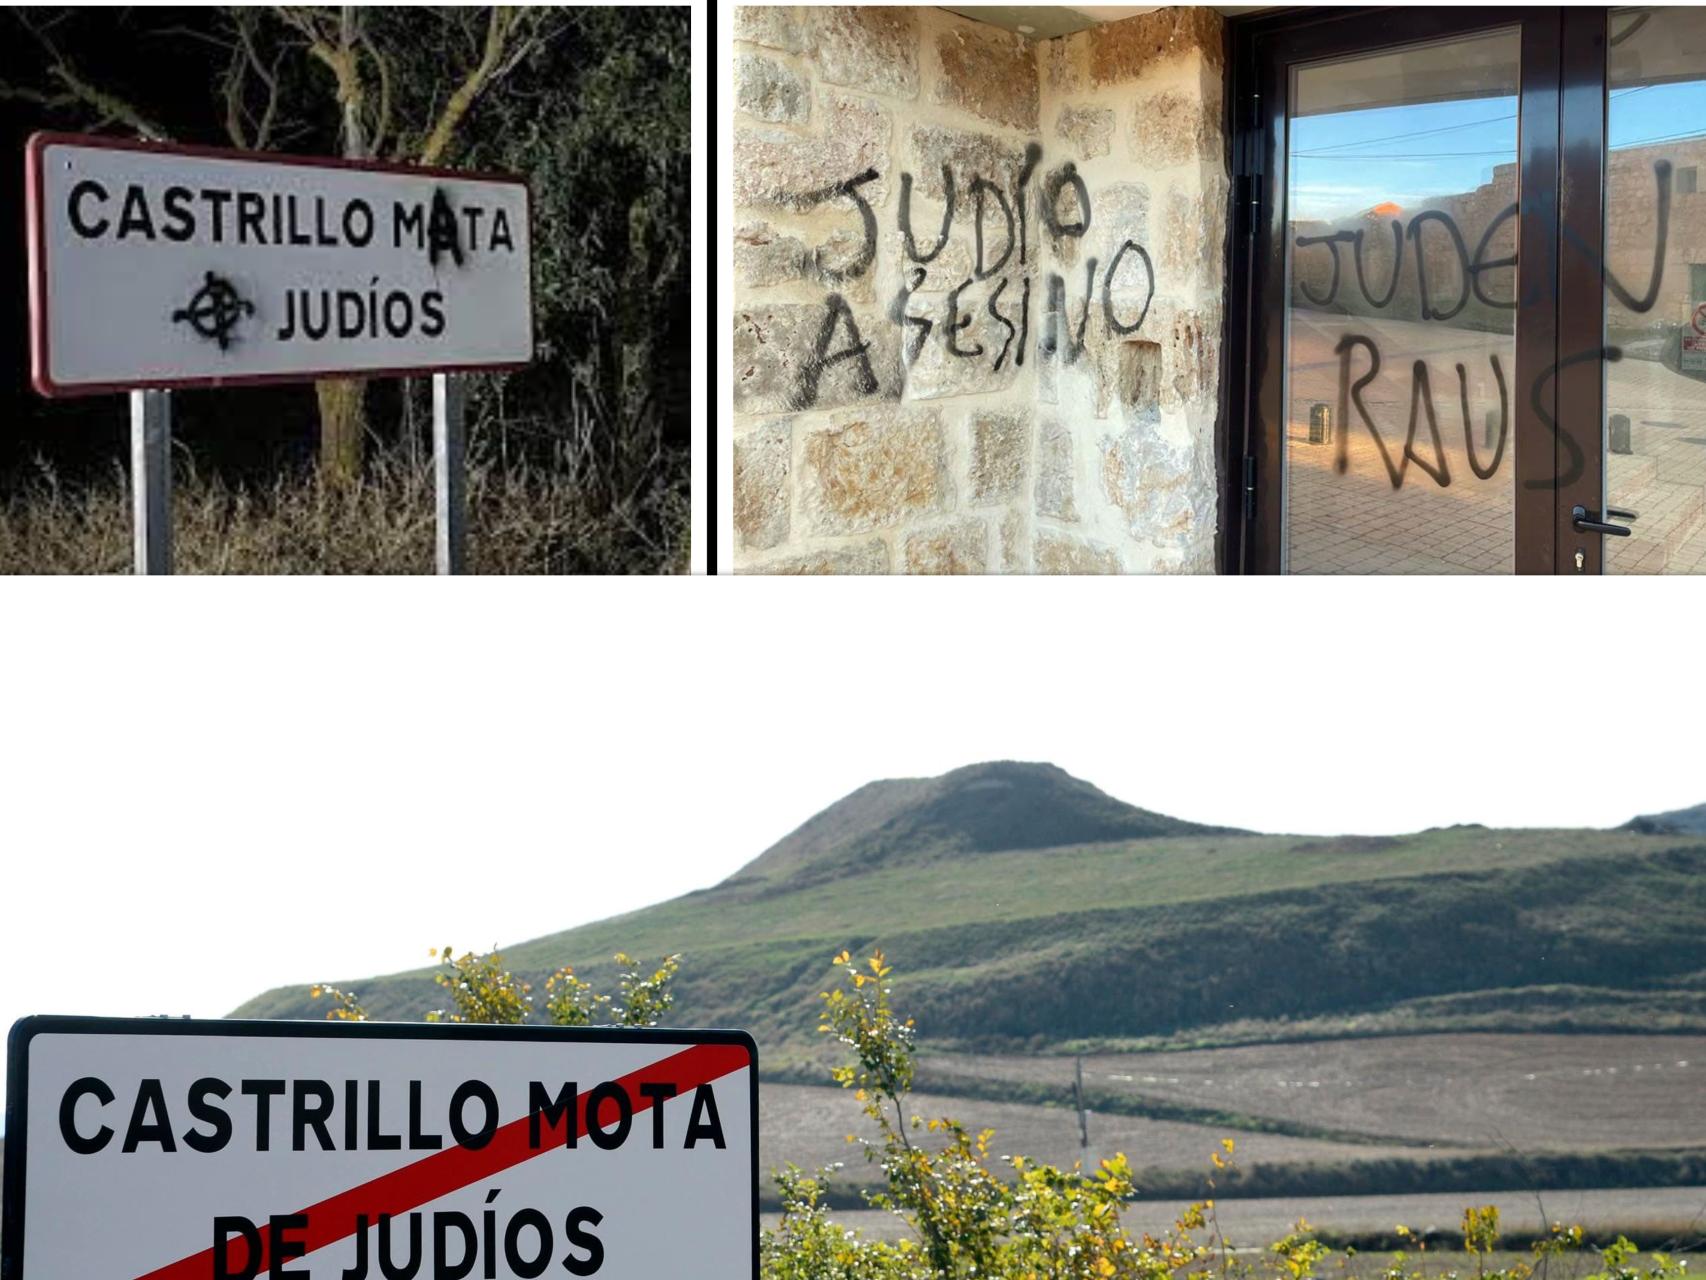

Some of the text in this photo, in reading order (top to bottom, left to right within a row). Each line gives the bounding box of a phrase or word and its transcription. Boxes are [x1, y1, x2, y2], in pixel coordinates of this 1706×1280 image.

[67, 180, 515, 267] CASTRILLO MATA
[278, 277, 446, 341] JUDÍOS
[790, 239, 1155, 408] ASESINO
[1334, 333, 1622, 490] RAUS
[58, 1076, 728, 1155] CASTRILLO MOTA
[213, 1189, 605, 1280] DE JUDÍOS
